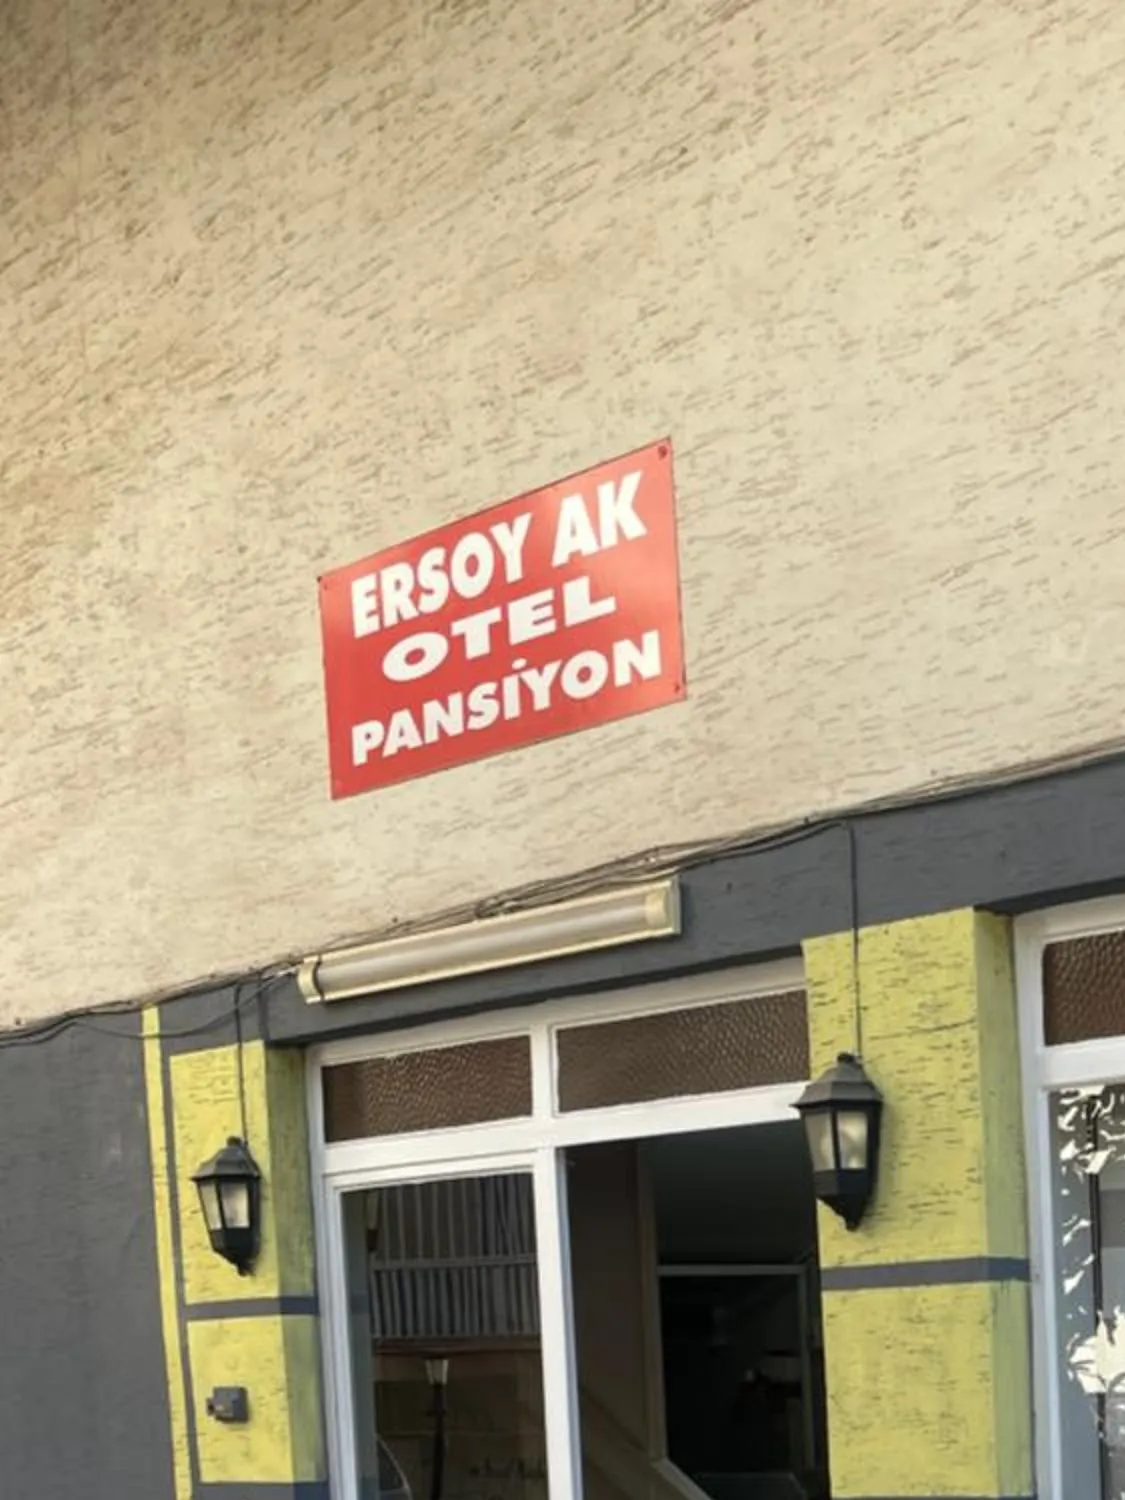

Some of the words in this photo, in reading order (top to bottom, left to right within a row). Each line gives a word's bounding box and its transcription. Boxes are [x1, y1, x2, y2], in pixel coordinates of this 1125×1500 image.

[351, 513, 532, 638] ERSOY
[552, 471, 647, 567] AK
[382, 576, 616, 682] OTEL
[352, 630, 662, 766] PANSİYON
